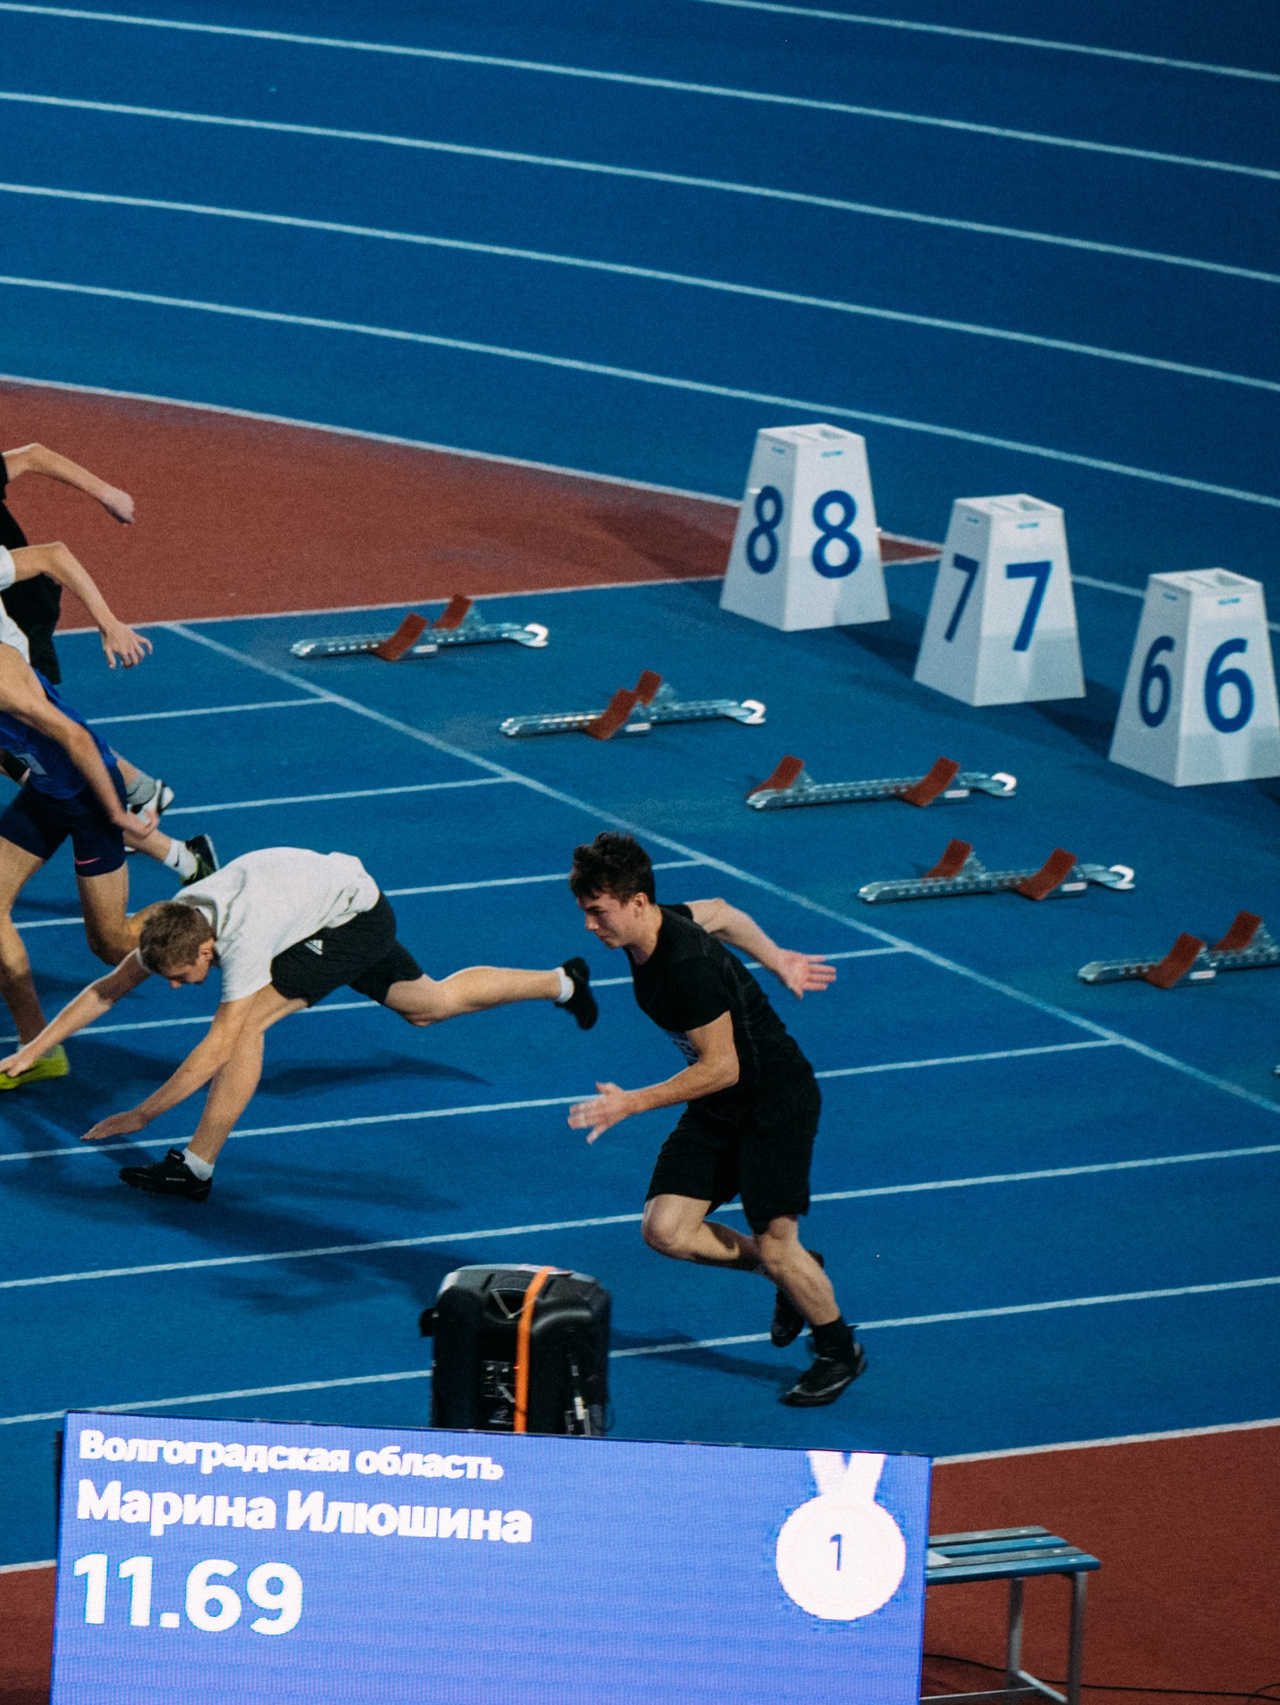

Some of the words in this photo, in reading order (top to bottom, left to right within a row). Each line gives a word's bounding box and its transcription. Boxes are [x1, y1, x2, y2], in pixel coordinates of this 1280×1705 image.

[746, 485, 784, 575] 8
[811, 489, 863, 579] 8
[944, 553, 980, 643] 7
[1005, 560, 1053, 652] 7
[1137, 635, 1175, 728] 6
[1203, 637, 1256, 734] 6
[79, 1429, 351, 1475] Волгоградская
[355, 1445, 505, 1481] область
[76, 1478, 277, 1537] Марина
[286, 1489, 533, 1544] Илюшина
[829, 1533, 843, 1572] 1
[73, 1552, 304, 1636] 11.69
